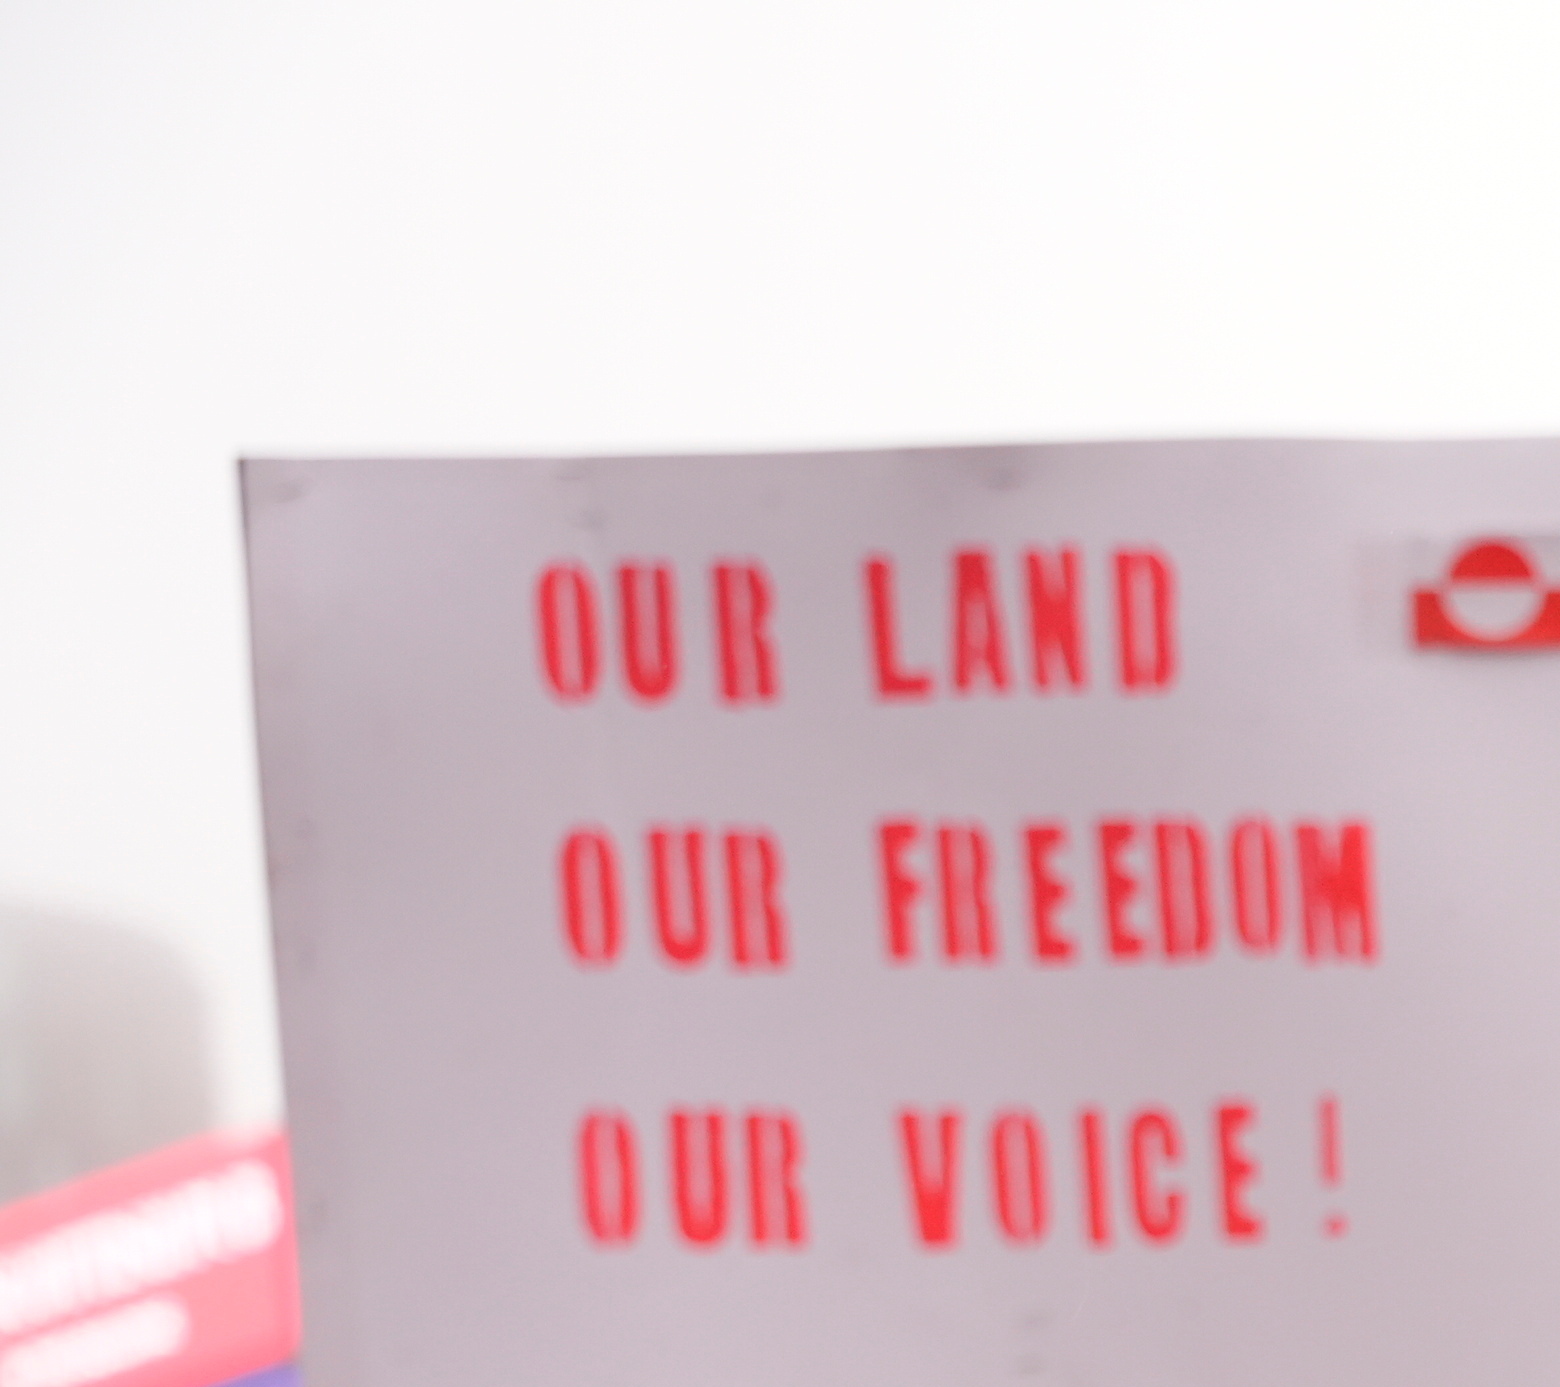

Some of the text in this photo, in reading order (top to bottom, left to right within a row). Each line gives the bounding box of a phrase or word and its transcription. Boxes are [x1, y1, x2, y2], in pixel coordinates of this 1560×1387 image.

[532, 542, 1182, 709] OUR LAND
[555, 813, 1382, 975] OUR FREEDOM
[573, 1104, 811, 1254] OUR
